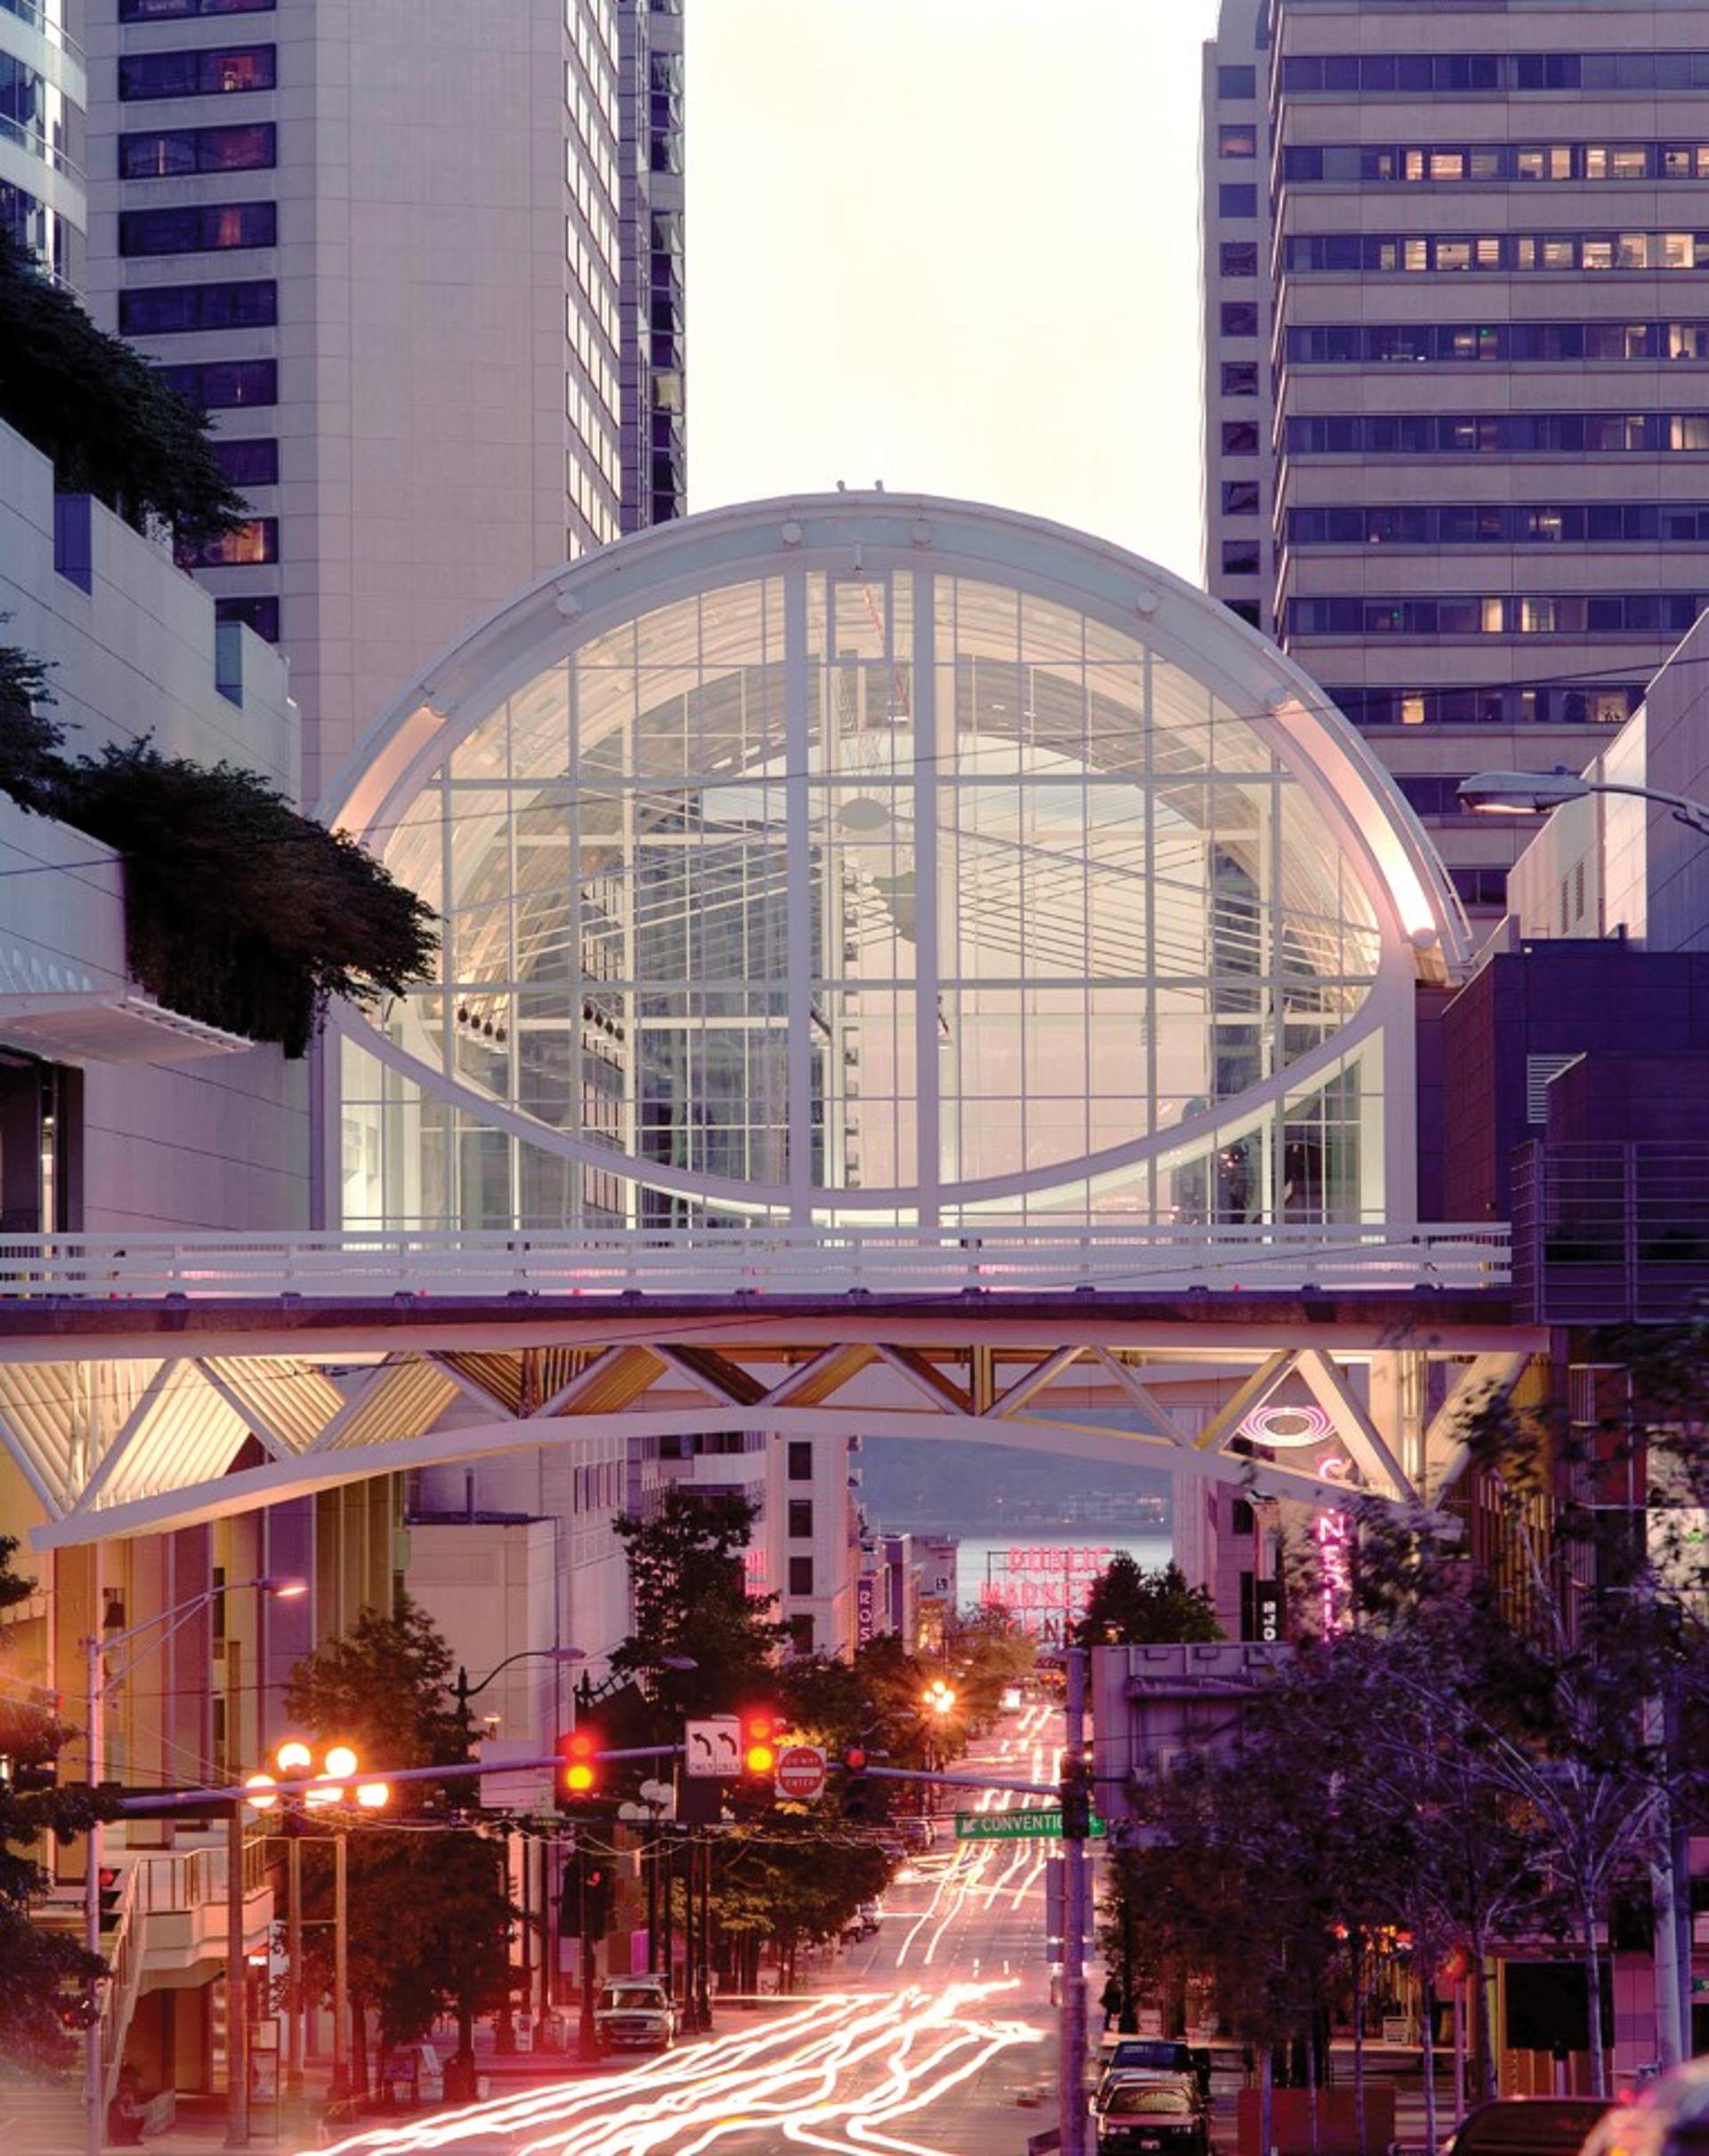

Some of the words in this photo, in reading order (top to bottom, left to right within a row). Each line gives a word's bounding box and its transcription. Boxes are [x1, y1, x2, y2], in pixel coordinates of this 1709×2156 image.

[1008, 1546, 1110, 1575] PUBLIC
[980, 1580, 1094, 1609] MARKET
[860, 1591, 872, 1651] ROS
[1006, 1617, 1079, 1644] CENT
[982, 1814, 1063, 1831] CONVENTI
